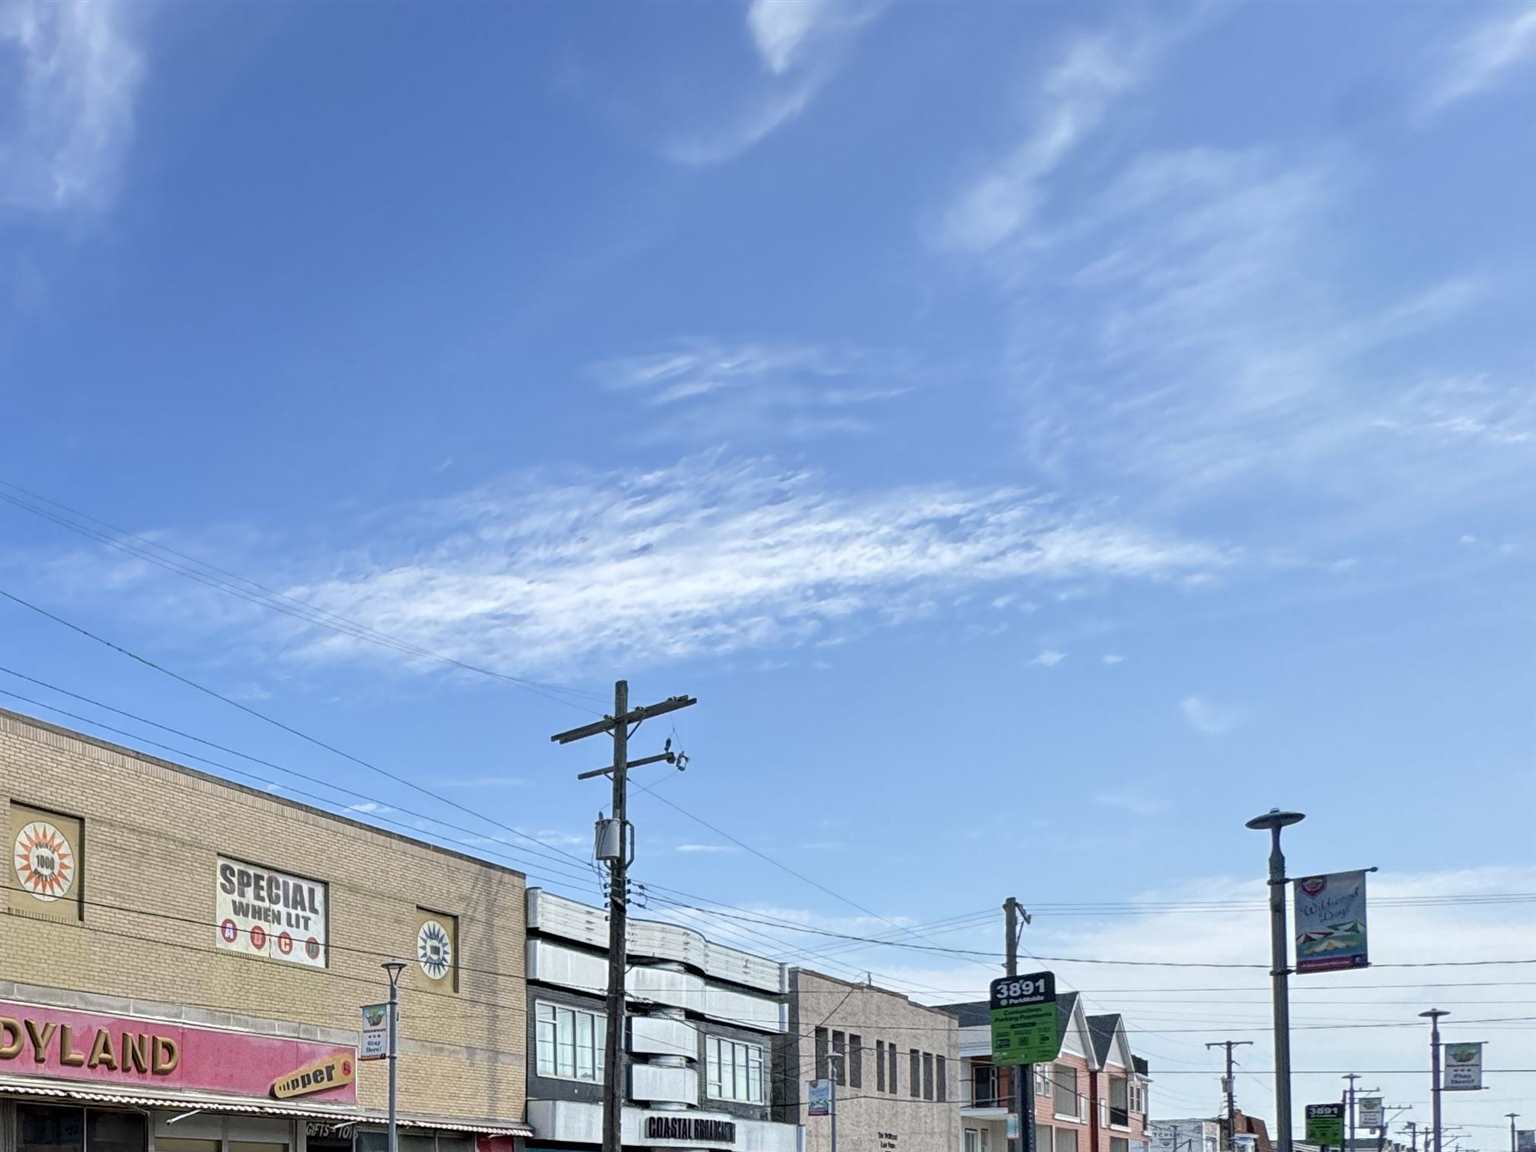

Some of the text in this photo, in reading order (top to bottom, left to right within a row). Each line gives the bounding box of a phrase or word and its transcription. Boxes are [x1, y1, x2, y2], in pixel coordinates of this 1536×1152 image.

[36, 854, 55, 871] 1000
[220, 863, 319, 915] SPECIAL
[231, 899, 312, 932] WHEN LIT
[996, 978, 1045, 999] 3891
[306, 1123, 330, 1137] GIFTS
[648, 1116, 692, 1140] COASTAL
